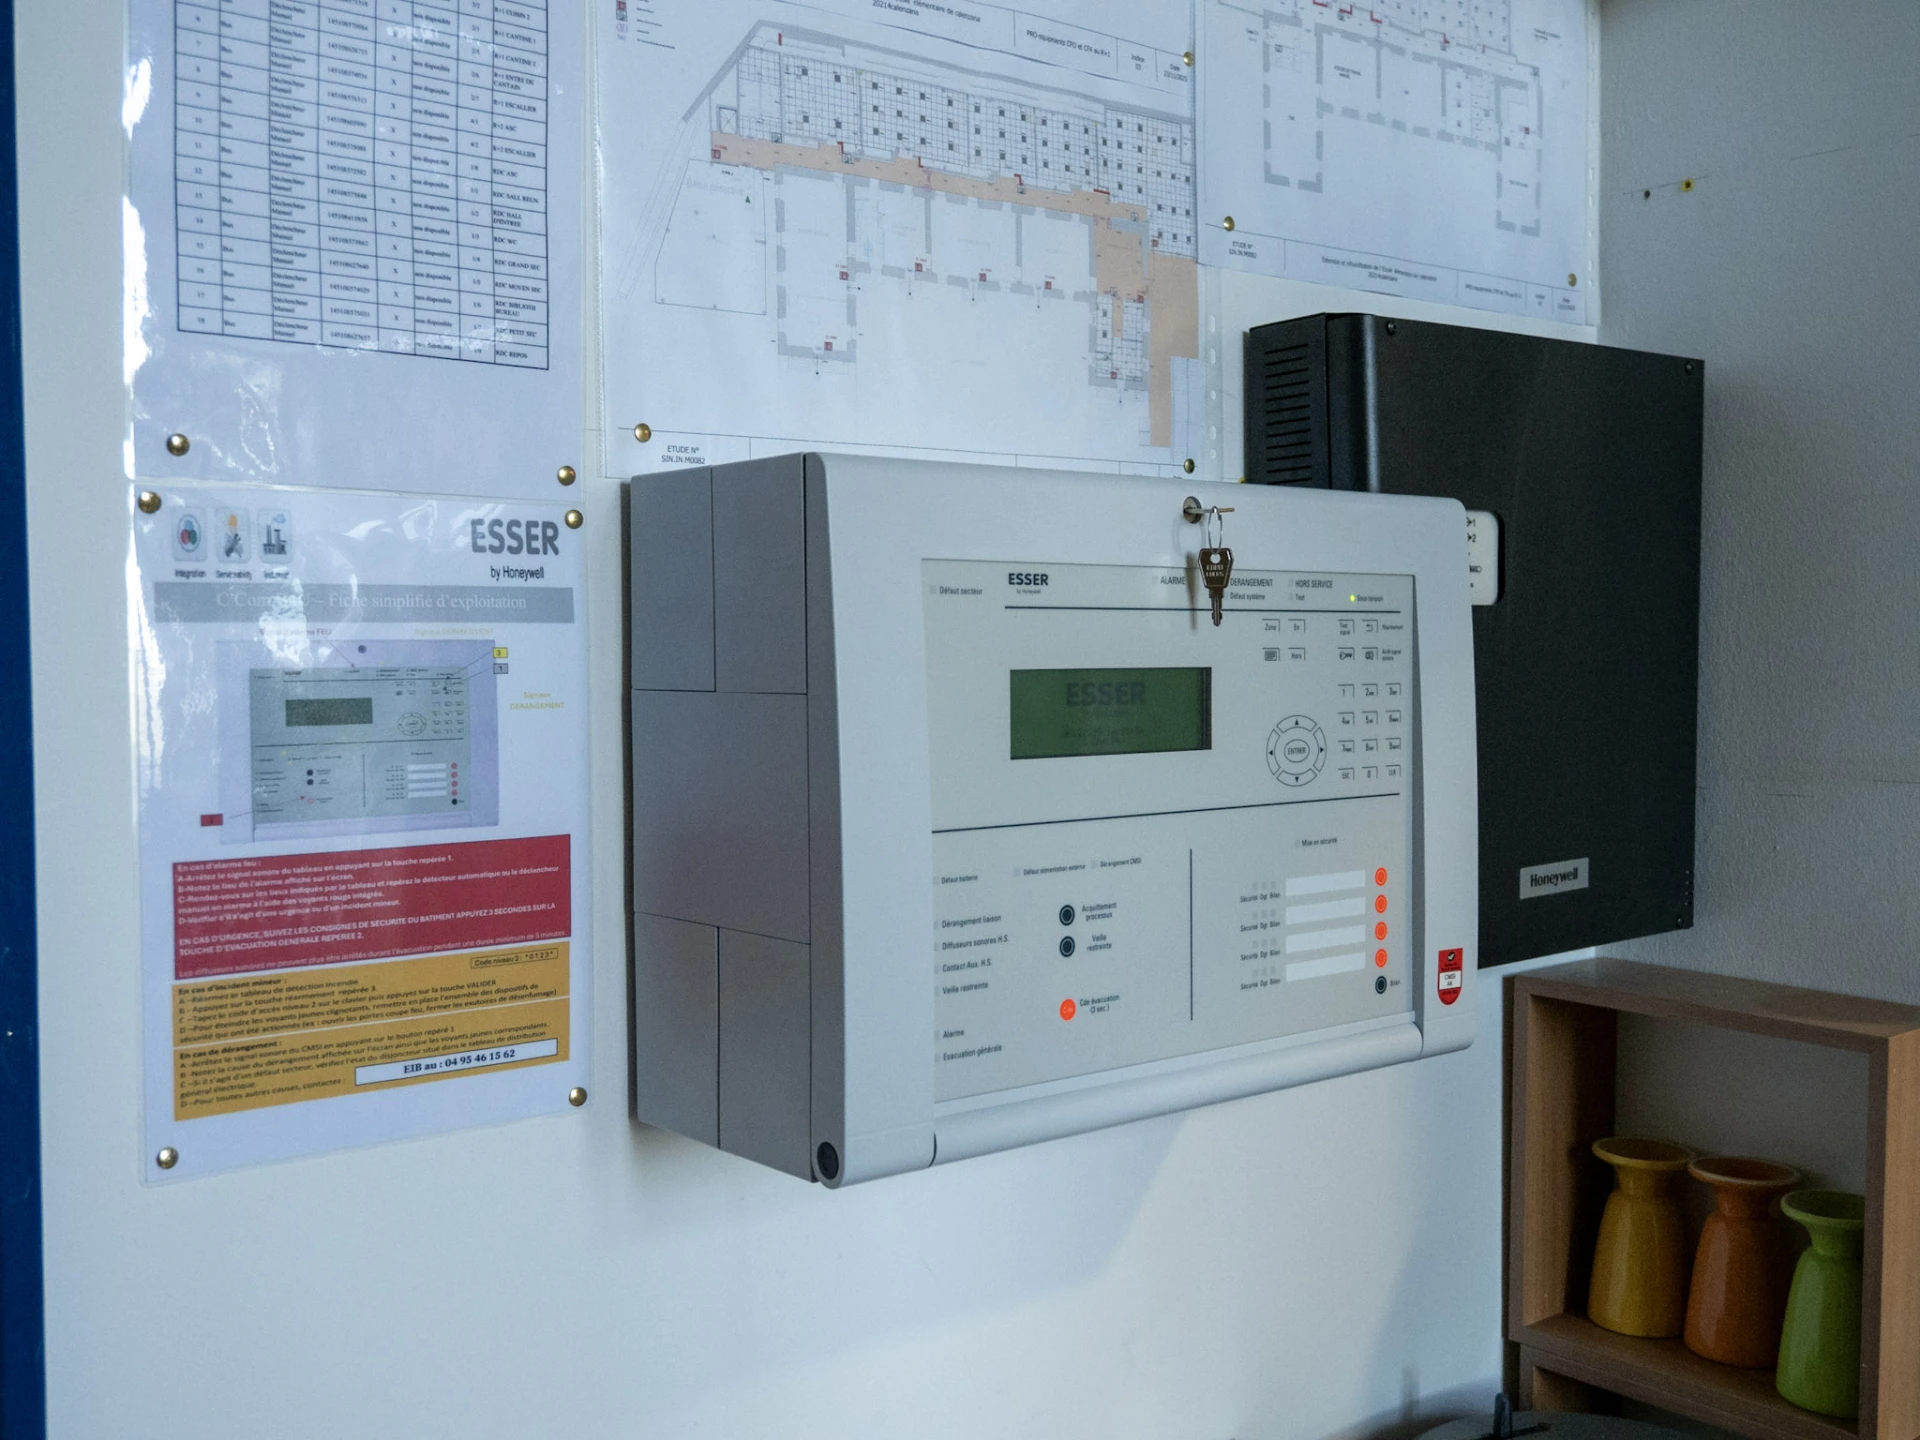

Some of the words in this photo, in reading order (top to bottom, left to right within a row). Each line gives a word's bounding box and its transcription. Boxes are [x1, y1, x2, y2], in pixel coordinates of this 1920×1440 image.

[668, 445, 689, 454] ETUDE
[470, 518, 560, 556] ESSER
[490, 566, 500, 581] by
[503, 566, 544, 582] Honeywell
[1008, 573, 1048, 585] ESSER
[1160, 576, 1185, 585] ALARME
[1230, 578, 1273, 588] DERANGEMENT
[1295, 580, 1310, 588] HORS
[1311, 580, 1333, 588] SERVICE
[939, 586, 959, 595] Défaut
[960, 587, 982, 595] secteur
[373, 594, 432, 612] simplifié
[1066, 682, 1145, 707] ESSER
[1288, 747, 1306, 755] ENTRER
[1530, 867, 1578, 887] Honeywell
[1082, 902, 1117, 913] Acquittement
[1085, 911, 1112, 921] processus
[179, 937, 190, 946] EN
[192, 936, 209, 944] CAS
[294, 926, 306, 934] LES
[307, 921, 357, 933] CONSIGNES
[358, 920, 369, 928] DE
[407, 915, 418, 923] DU
[420, 912, 454, 922] BATIMENT
[456, 909, 487, 918] APPUYEZ
[494, 905, 531, 915] SECONDES
[532, 903, 546, 911] SUR
[942, 917, 981, 928] Dérangement
[180, 946, 211, 956] TOUCHE
[278, 935, 318, 946] GENERALE
[321, 932, 355, 942] REPEREE
[942, 940, 972, 950] Diffuseurs
[974, 937, 997, 946] sonores
[1092, 934, 1107, 942] Veille
[474, 958, 491, 966] Code
[492, 955, 513, 964] niveau
[942, 963, 966, 972] Contact
[943, 986, 959, 995] Veille
[960, 982, 988, 992] restreinte
[1080, 998, 1090, 1007] Cde
[1091, 994, 1120, 1005] évacuation
[943, 1029, 964, 1038] Alarme
[180, 1052, 190, 1060] En
[192, 1050, 206, 1058] cas
[208, 1048, 219, 1056] de
[221, 1040, 276, 1054] dérangement
[977, 1044, 1002, 1057] générale
[404, 1062, 421, 1073] EIB
[424, 1060, 436, 1070] au
[445, 1057, 457, 1067] 04
[460, 1055, 471, 1065] 95
[474, 1053, 487, 1063] 46
[490, 1051, 500, 1060] 15
[503, 1049, 515, 1058] 62
